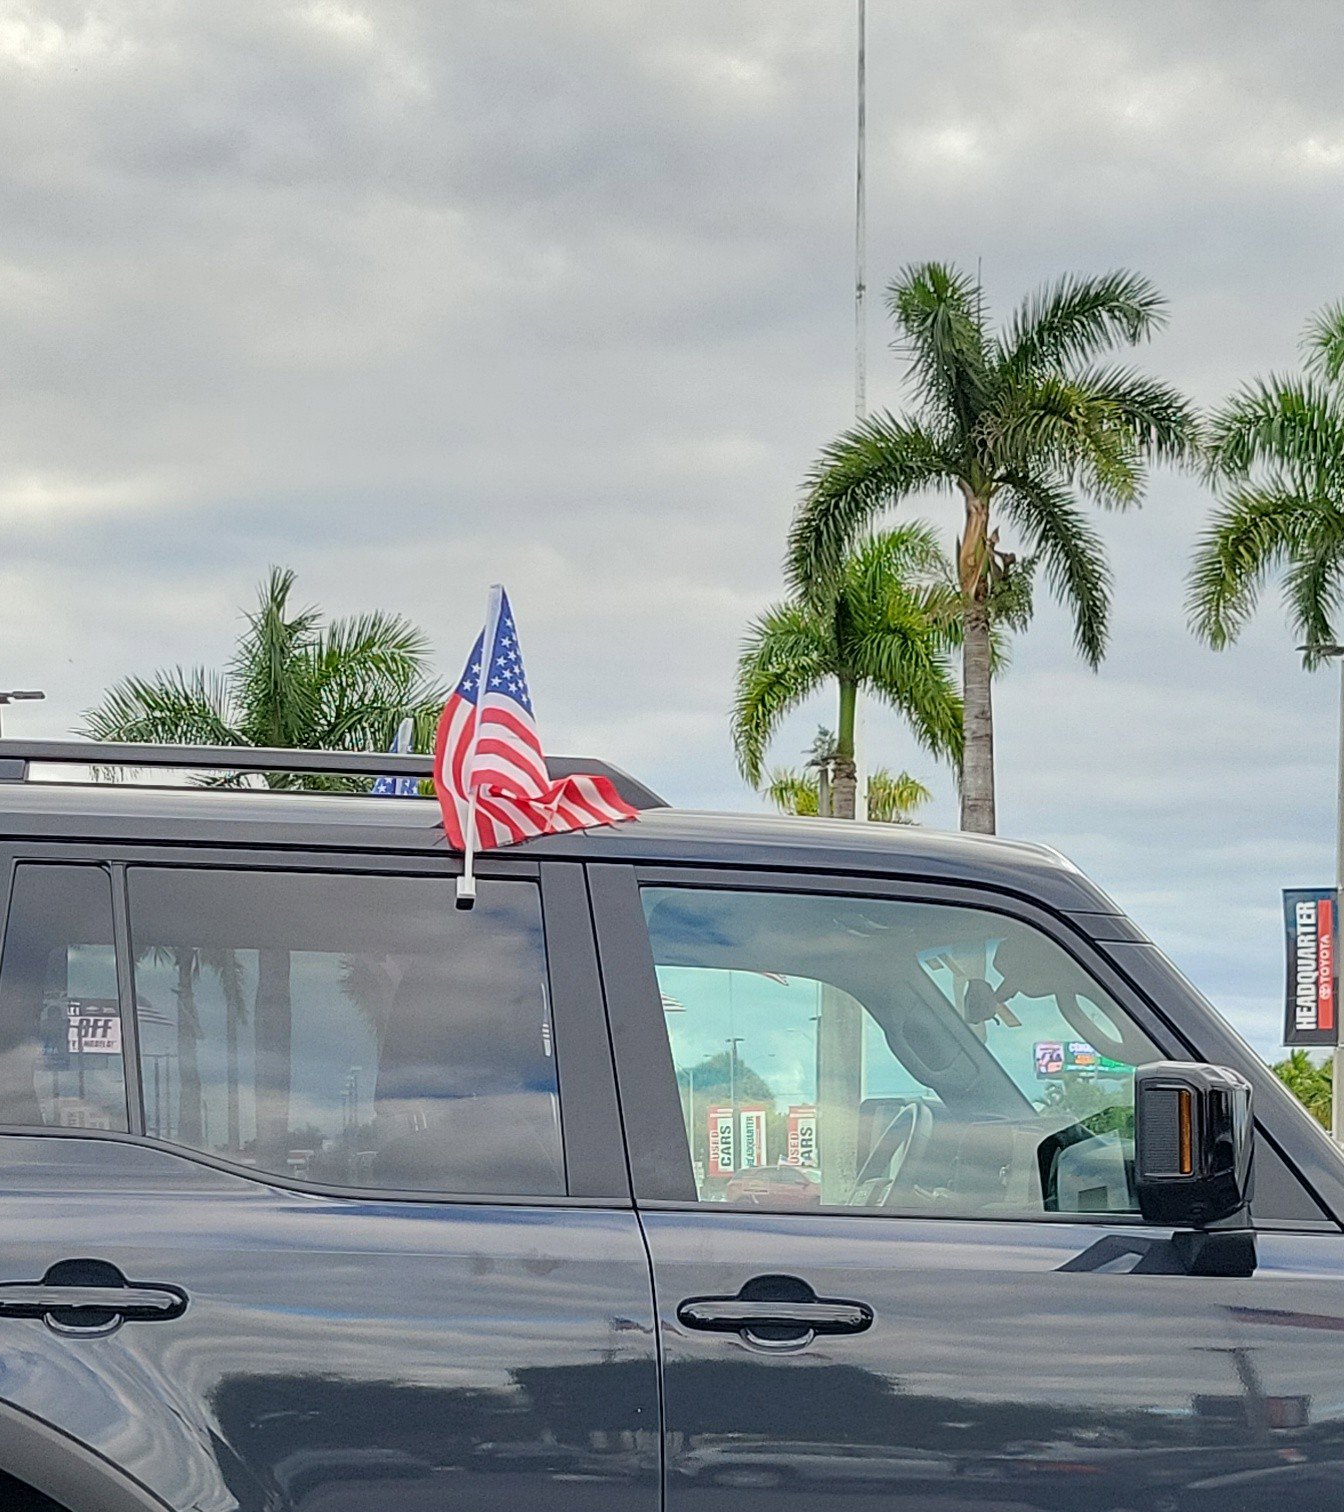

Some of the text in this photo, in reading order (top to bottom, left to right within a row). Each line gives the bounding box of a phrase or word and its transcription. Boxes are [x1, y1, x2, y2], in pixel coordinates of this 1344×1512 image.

[1296, 901, 1318, 1030] HEADQUARTER
[1320, 935, 1331, 983] TOYOTA
[720, 1125, 732, 1167] CARS
